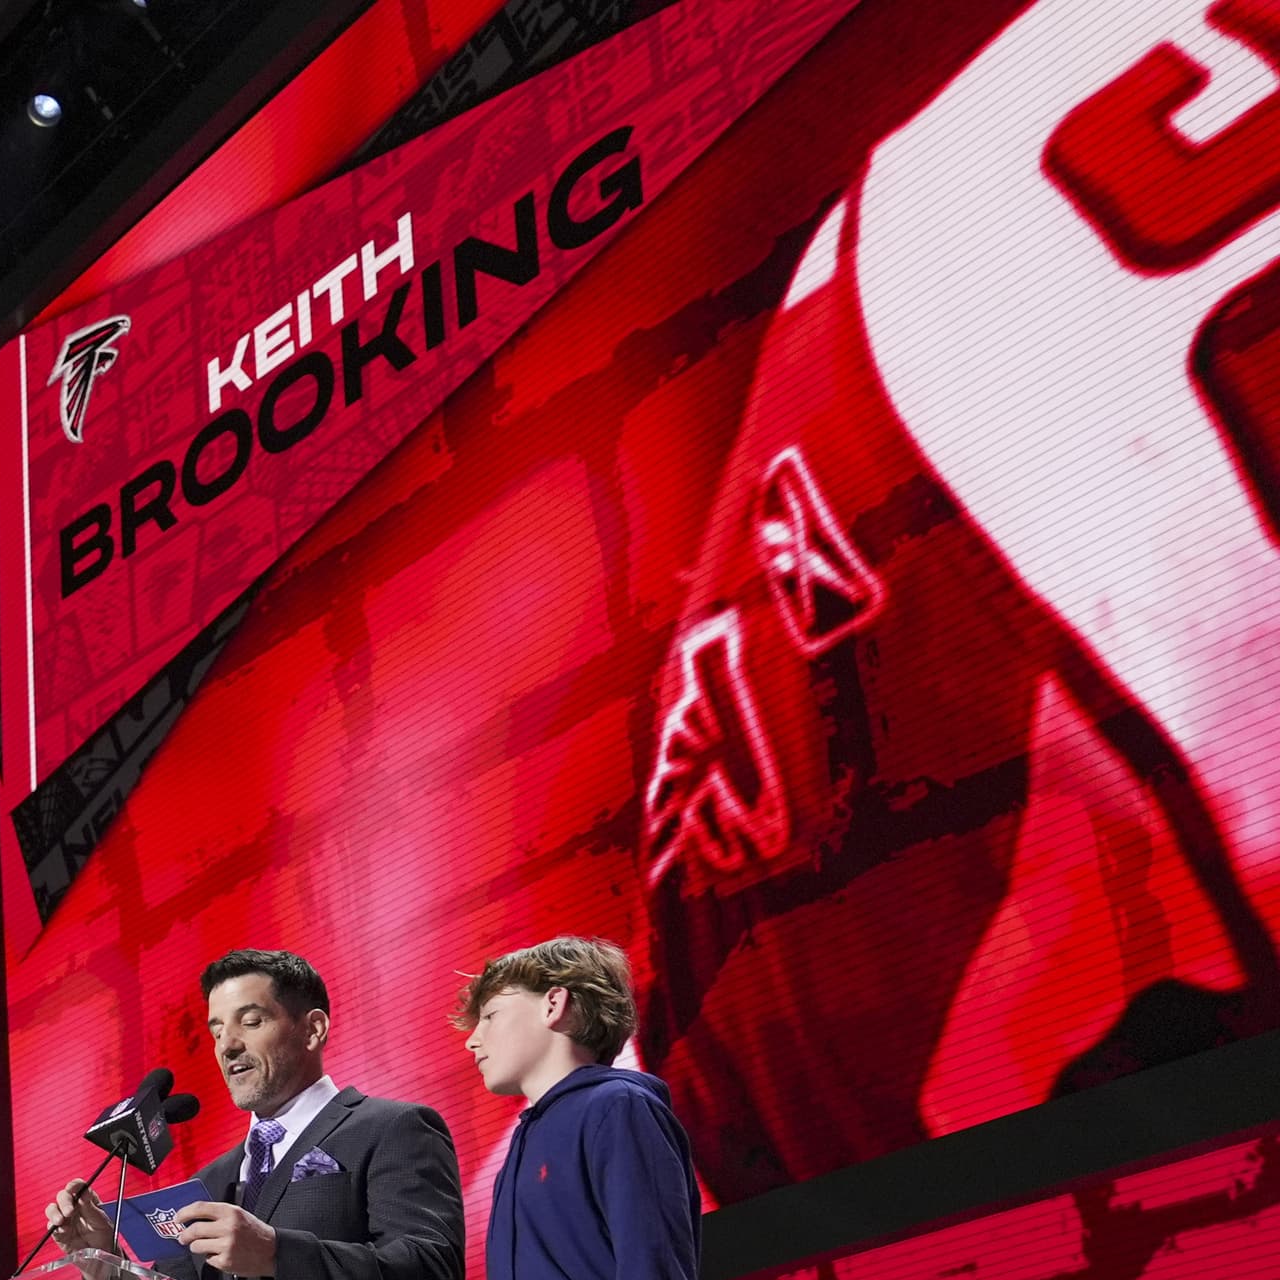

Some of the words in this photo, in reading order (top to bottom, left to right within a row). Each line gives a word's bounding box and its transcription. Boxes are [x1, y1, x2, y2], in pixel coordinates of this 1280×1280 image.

[59, 125, 643, 598] BROOKING
[207, 211, 415, 414] KEITH
[135, 1110, 157, 1170] NETWORK
[157, 1221, 184, 1236] NFL
